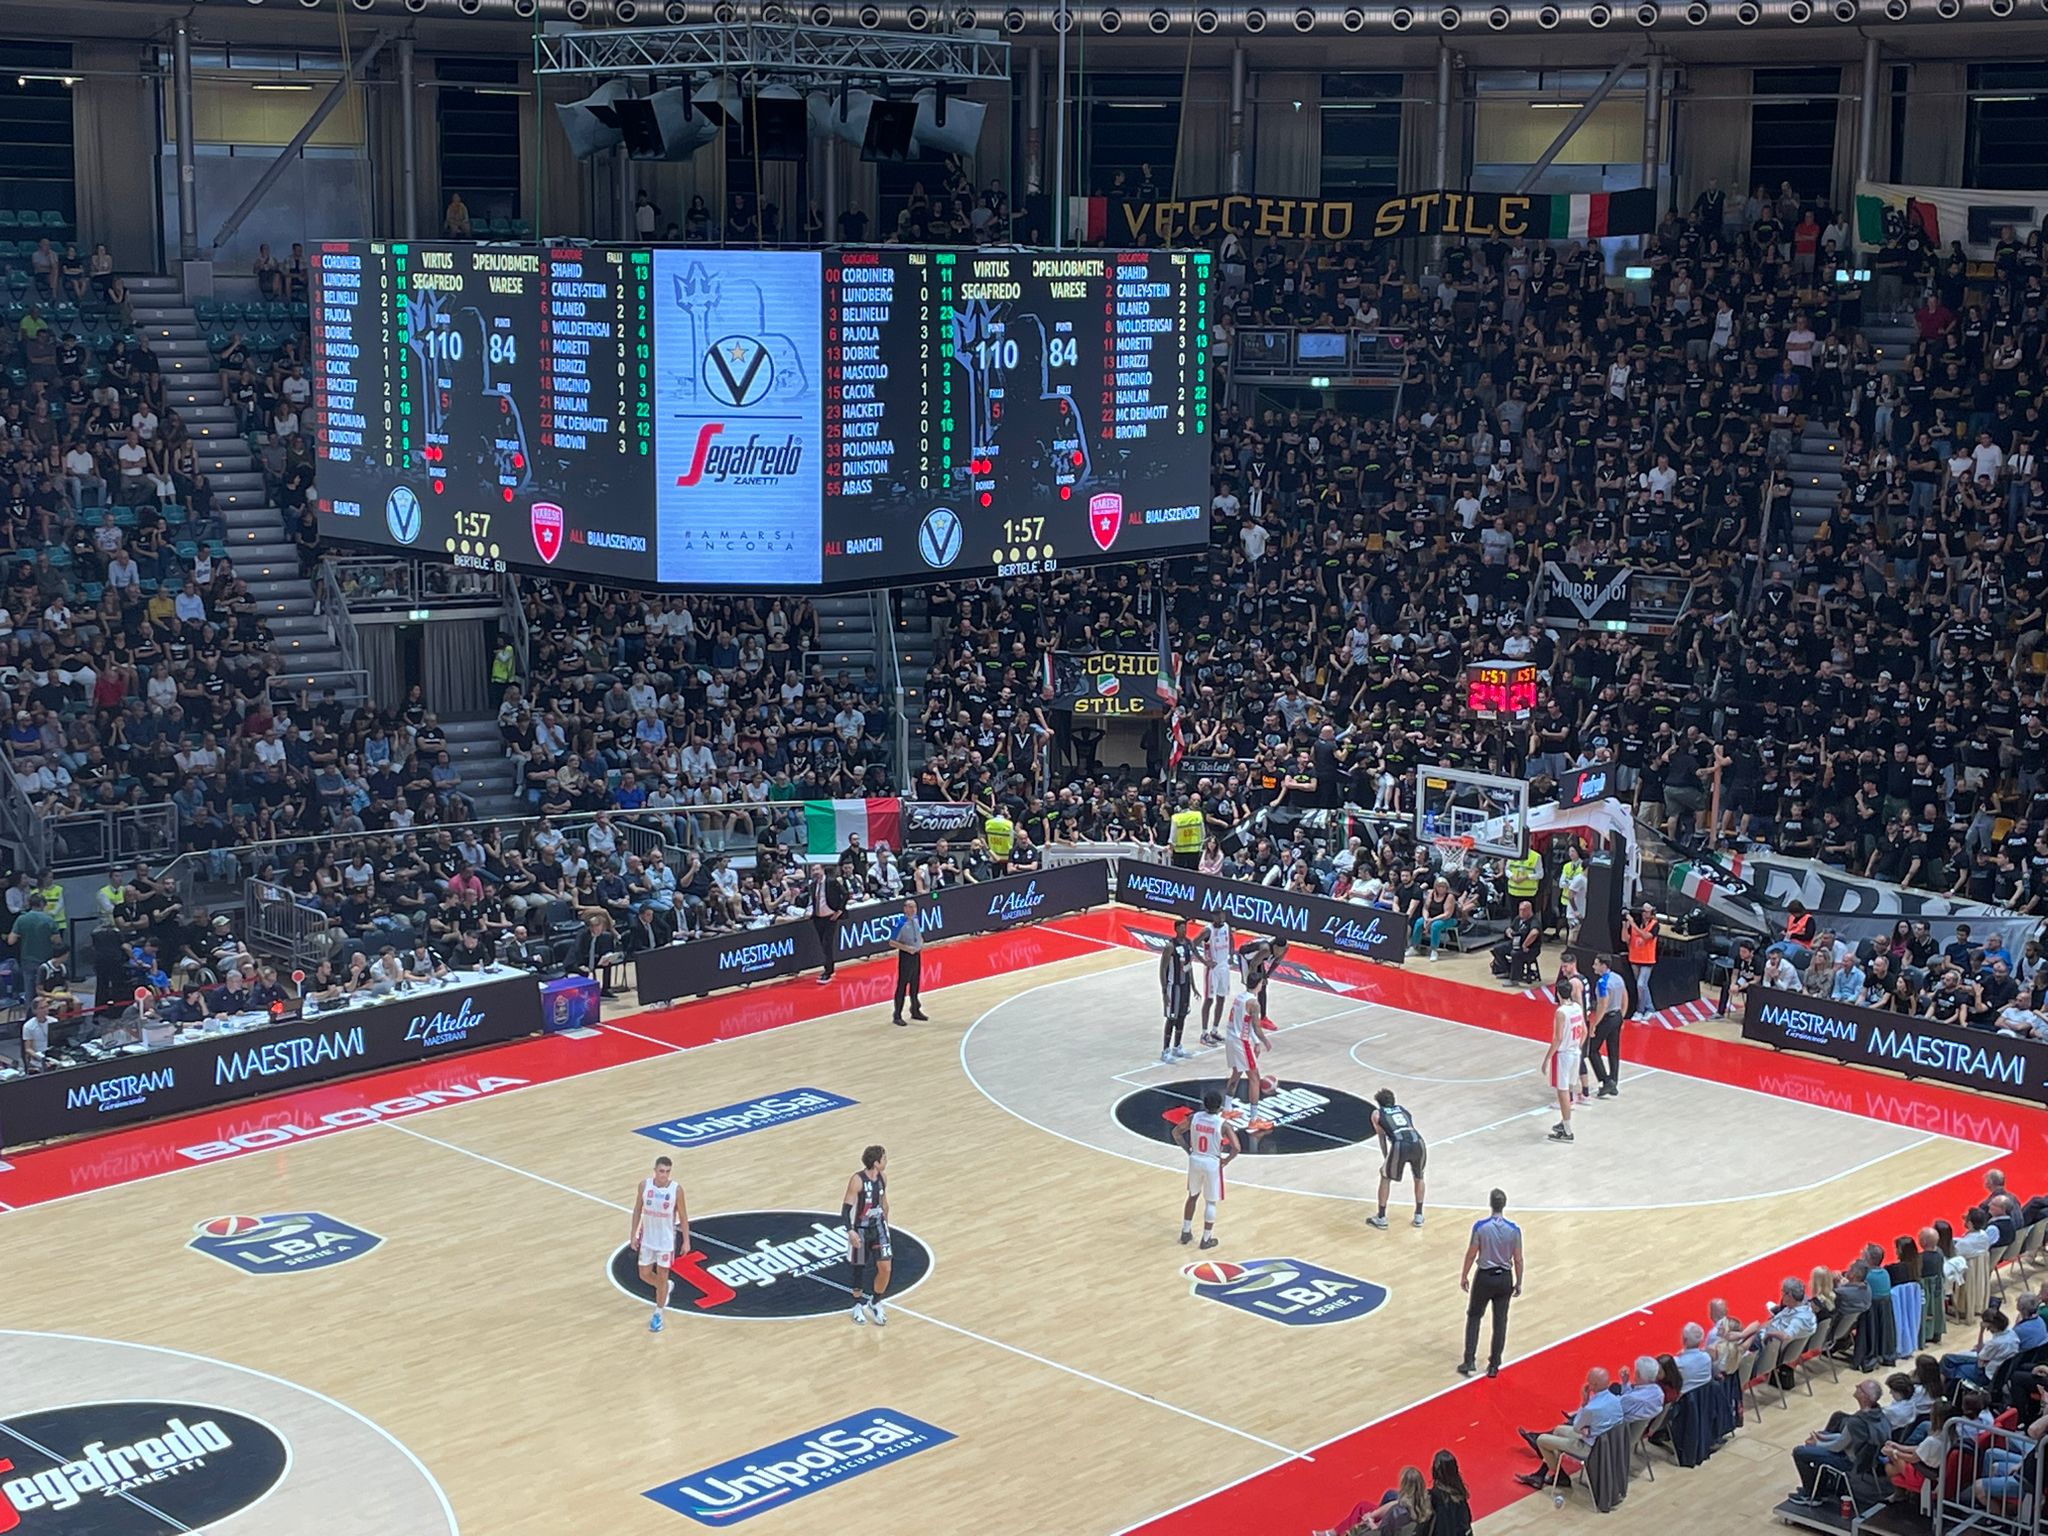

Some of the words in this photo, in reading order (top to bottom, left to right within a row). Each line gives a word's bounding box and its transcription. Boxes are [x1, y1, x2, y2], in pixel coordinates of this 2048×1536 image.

[1122, 194, 1353, 241] VECCHIO
[1374, 192, 1530, 236] STILE
[421, 252, 453, 269] VIRTUS
[909, 254, 926, 265] FALLI
[973, 261, 1009, 277] VIRTUS
[413, 273, 463, 291] SEGAFREDO
[826, 269, 840, 282] 00
[842, 268, 894, 283] CORDINIER
[921, 268, 927, 282] 1
[941, 268, 952, 282] 11
[1117, 266, 1147, 280] SHAHID
[489, 277, 523, 293] VARESE
[830, 288, 835, 301] 1
[842, 287, 893, 302] LUNDBERG
[921, 287, 928, 300] 0
[941, 287, 952, 300] 11
[961, 282, 1020, 299] SEGAFREDO
[1050, 282, 1086, 298] VARESE
[830, 307, 836, 321] 3
[842, 307, 888, 321] BELINELLI
[921, 306, 928, 321] 2
[940, 306, 954, 320] 23
[829, 327, 836, 340] 6
[842, 326, 879, 341] PAJOLA
[921, 325, 928, 339] 3
[941, 325, 953, 339] 13
[425, 331, 462, 360] 110
[490, 334, 516, 364] 84
[827, 348, 840, 360] 13
[842, 346, 880, 360] DOBRIC
[921, 344, 928, 358] 2
[941, 344, 953, 357] 10
[1050, 338, 1078, 366] 84
[1116, 337, 1152, 351] MORETTI
[976, 340, 1018, 370] 110
[827, 367, 840, 380] 14
[842, 364, 888, 379] MASCOLO
[922, 363, 927, 377] 1
[944, 362, 950, 376] 2
[827, 387, 840, 399] 15
[842, 384, 875, 399] CACOK
[922, 382, 927, 396] 1
[944, 381, 950, 394] 3
[1116, 390, 1149, 404] HANLAN
[826, 405, 840, 418] 23
[842, 403, 885, 418] HACKETT
[921, 401, 928, 414] 2
[944, 399, 950, 413] 2
[1130, 406, 1168, 420] DERMOTT
[827, 425, 840, 437] 25
[842, 422, 879, 438] MICKEY
[921, 420, 928, 433] 0
[941, 418, 954, 432] 16
[1116, 424, 1146, 439] BROWN
[676, 423, 802, 486] Segafredo
[827, 444, 840, 457] 33
[842, 440, 894, 457] POLONARA
[921, 438, 928, 452] 0
[943, 437, 950, 450] 8
[826, 463, 840, 476] 42
[842, 460, 888, 476] DUNSTON
[920, 457, 928, 471] 2
[943, 455, 950, 469] 9
[733, 477, 778, 485] ZANETTI
[827, 482, 840, 496] 55
[842, 480, 872, 495] ABASS
[921, 476, 928, 489] 0
[943, 474, 950, 487] 2
[454, 510, 490, 537] 1:57
[1003, 517, 1045, 543] 1:57
[846, 538, 882, 554] BANCHI
[1552, 580, 1598, 600] MURRI
[1605, 584, 1626, 600] 101
[1481, 670, 1506, 684] 1:57
[1074, 698, 1144, 713] STILE
[988, 880, 1045, 915] L'Atelier
[1128, 874, 1194, 901] MAESTRAMI
[1202, 888, 1309, 932] MAESTRAMI
[1321, 916, 1388, 944] L'Atelier
[719, 938, 794, 970] MAESTRAMI
[67, 1067, 174, 1109] MAESTRAMI
[216, 1027, 364, 1086] MAESTRAMI
[404, 998, 485, 1041] L'Atelier
[1760, 1004, 1857, 1041] MAESTRAMI
[1868, 1027, 2026, 1084] MAESTRAMI
[176, 1076, 531, 1162] BOLOGNA
[659, 1093, 829, 1138] UnipolSai
[237, 1231, 358, 1264] LBA
[284, 1249, 335, 1265] SERIE
[1253, 1280, 1359, 1315] LBA
[1309, 1298, 1351, 1316] SERIE
[679, 1418, 914, 1506] UnipolSai
[810, 1434, 929, 1482] ASSICURAZIONI
[100, 1458, 205, 1496] ZANETTI
